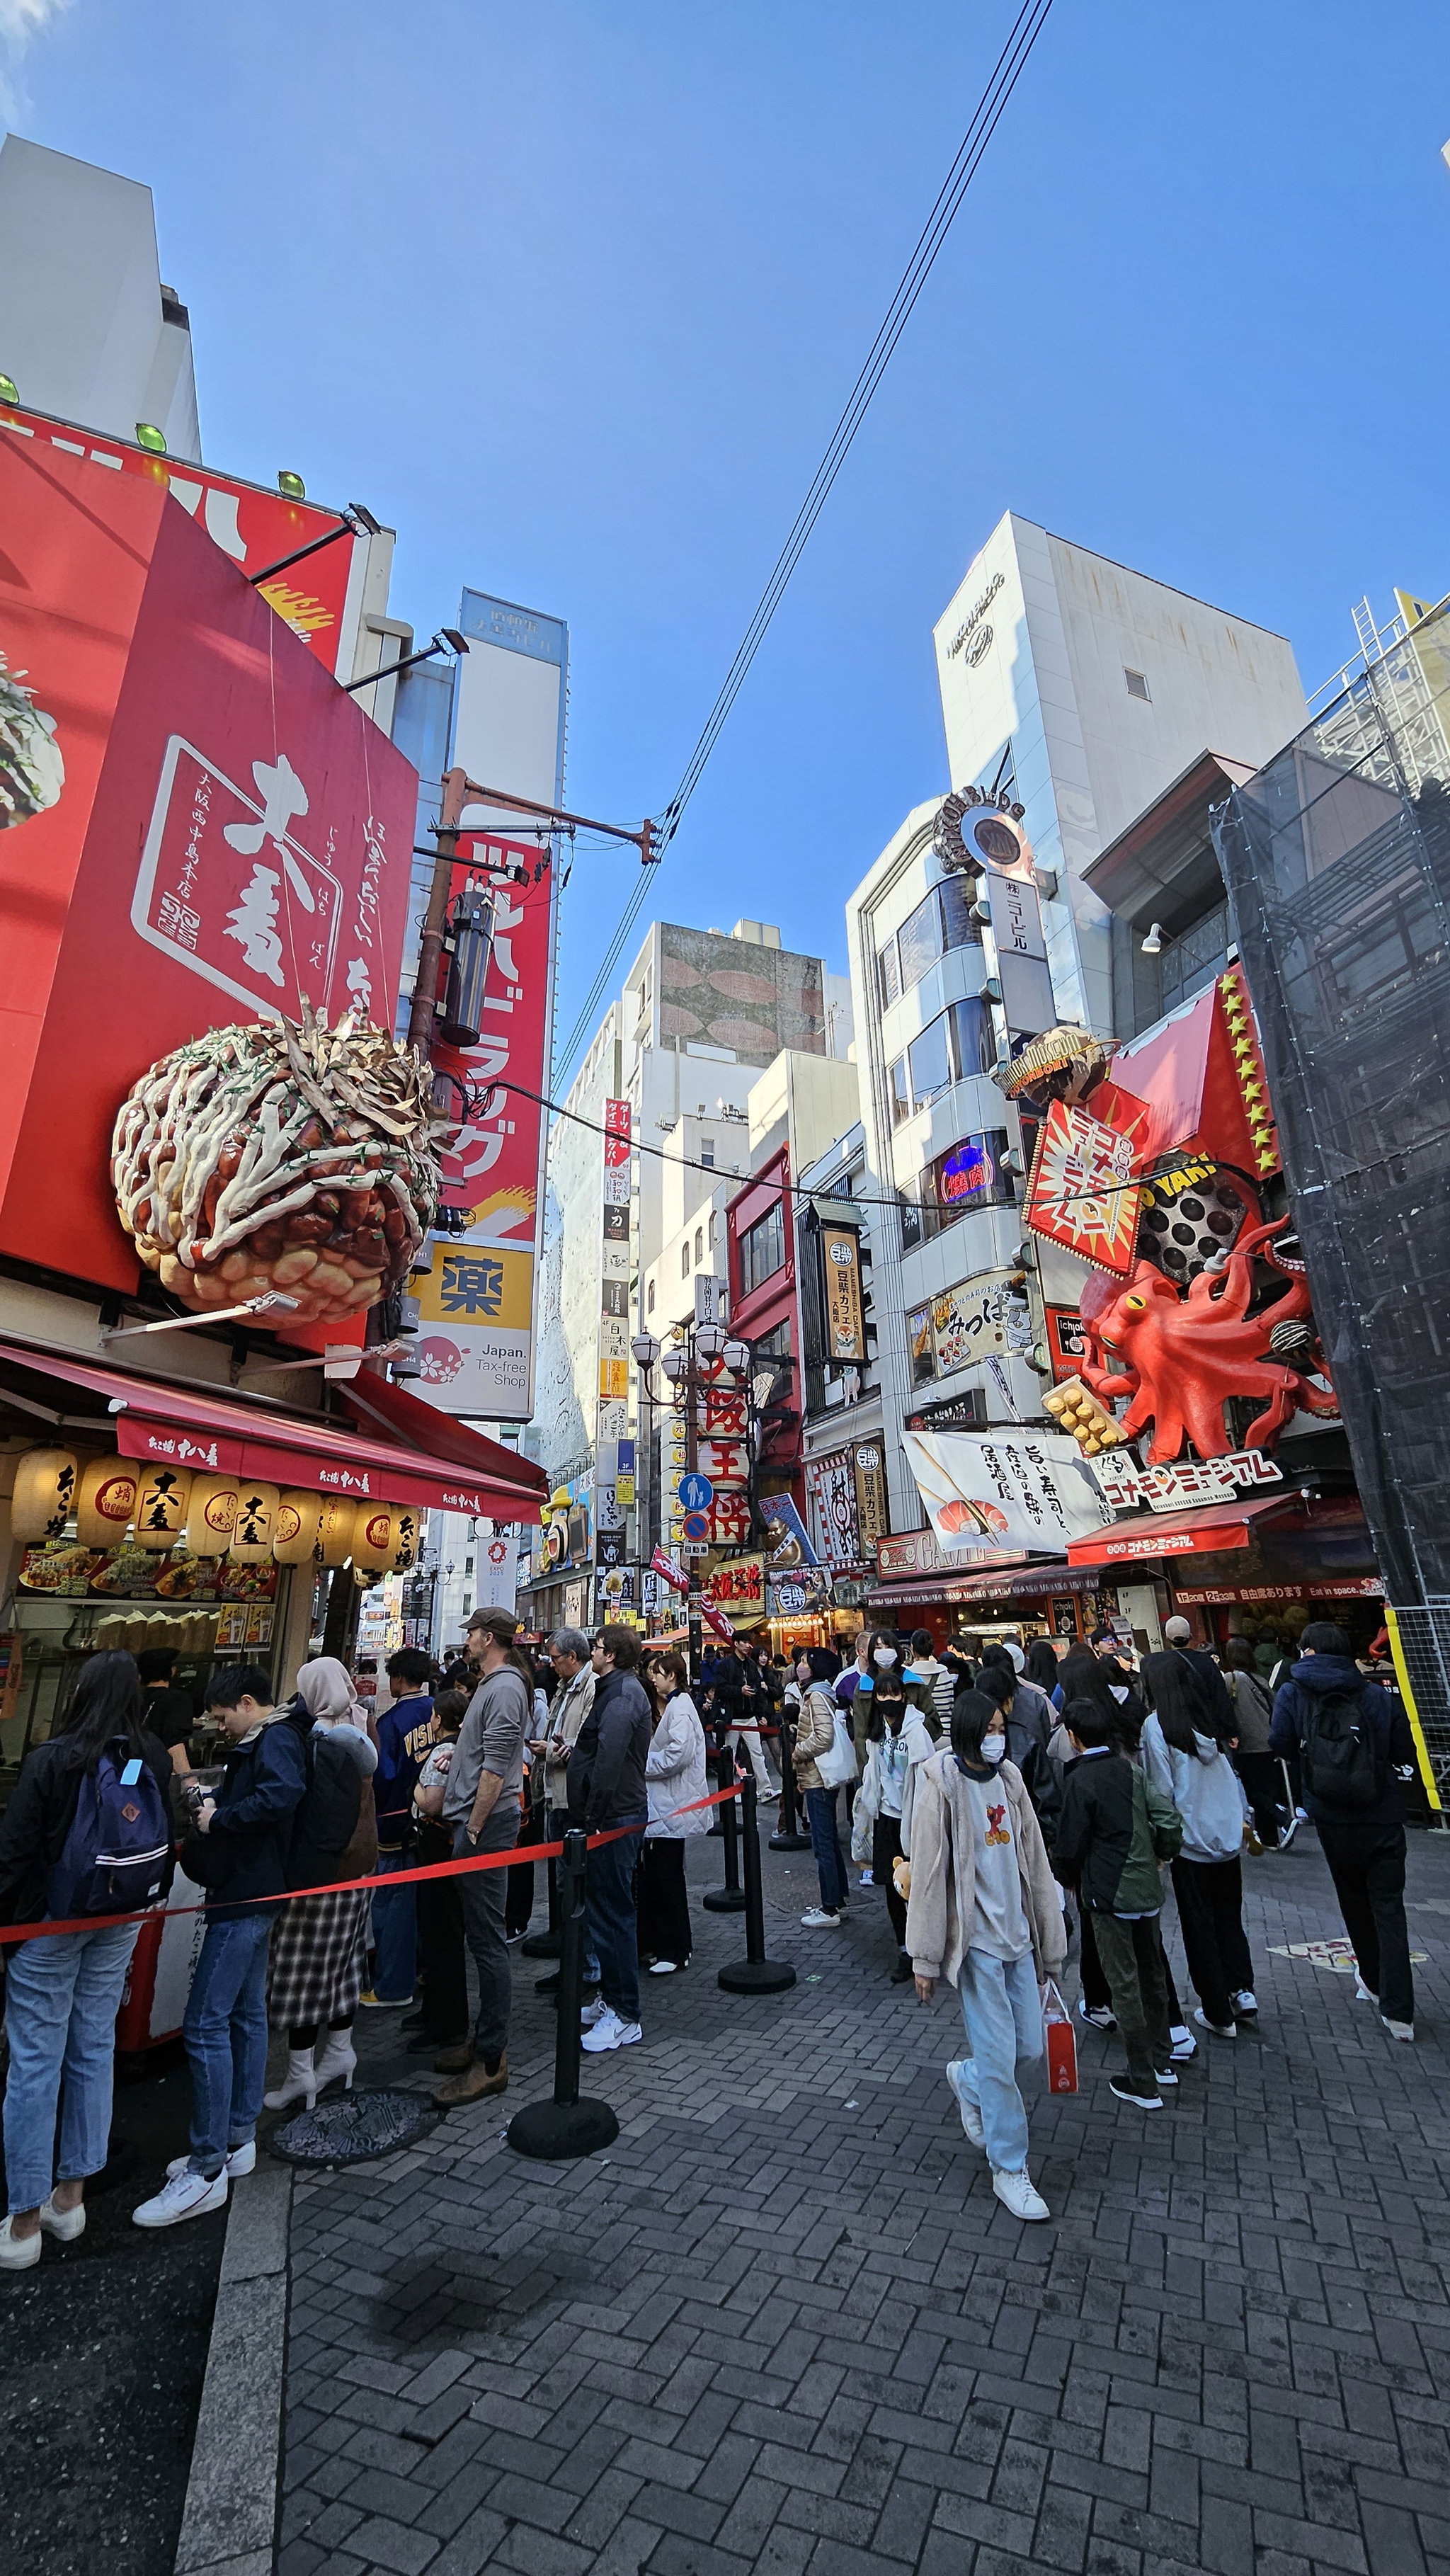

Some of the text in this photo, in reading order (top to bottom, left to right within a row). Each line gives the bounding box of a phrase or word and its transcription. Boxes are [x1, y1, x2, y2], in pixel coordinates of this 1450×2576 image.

[176, 773, 213, 900] 大阪西中島本店
[1027, 1033, 1081, 1071] MUSEUM
[1154, 1151, 1217, 1197] YAKI
[440, 1255, 503, 1317] 薬
[837, 1270, 851, 1325] 豆柴カフェ
[948, 1292, 1012, 1336] みつば
[481, 1343, 527, 1360] Japan.
[609, 1323, 627, 1356] 白木屋
[476, 1359, 527, 1374] Tax-free
[494, 1373, 526, 1389] Shop
[148, 1436, 176, 1454] たこ焼
[981, 1444, 1014, 1500] 居酒屋
[864, 1473, 877, 1529] 豆柴カフェ
[394, 1515, 416, 1568] たこ焼
[685, 1545, 708, 1554] 自動車
[1177, 1593, 1188, 1602] 1F
[1207, 1592, 1219, 1601] 2F
[1240, 1585, 1302, 1600] 自由席あります
[1310, 1588, 1323, 1596] Eat
[1324, 1587, 1332, 1595] in
[1333, 1586, 1359, 1596] space.
